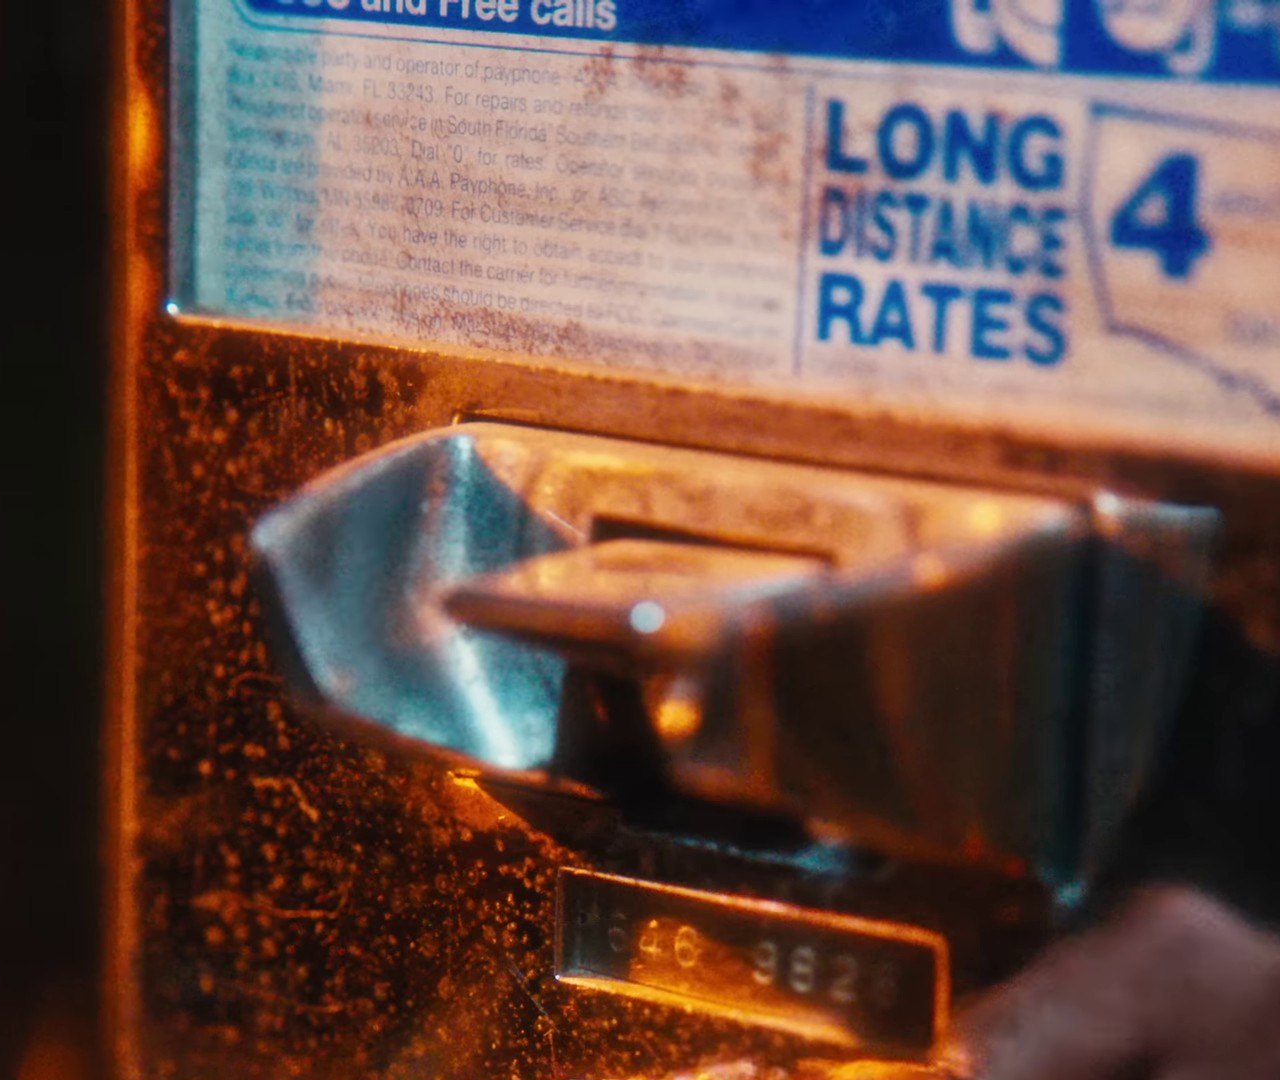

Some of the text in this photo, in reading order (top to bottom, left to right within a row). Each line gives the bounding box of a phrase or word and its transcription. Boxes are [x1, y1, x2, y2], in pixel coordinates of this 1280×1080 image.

[396, 57, 462, 80] operator
[444, 84, 472, 106] For
[474, 89, 528, 113] repairs
[447, 114, 492, 136] South
[826, 98, 1066, 192] LONG
[820, 187, 1067, 282] DISTANCE
[1109, 152, 1212, 282] 4
[815, 272, 1069, 367] RATES
